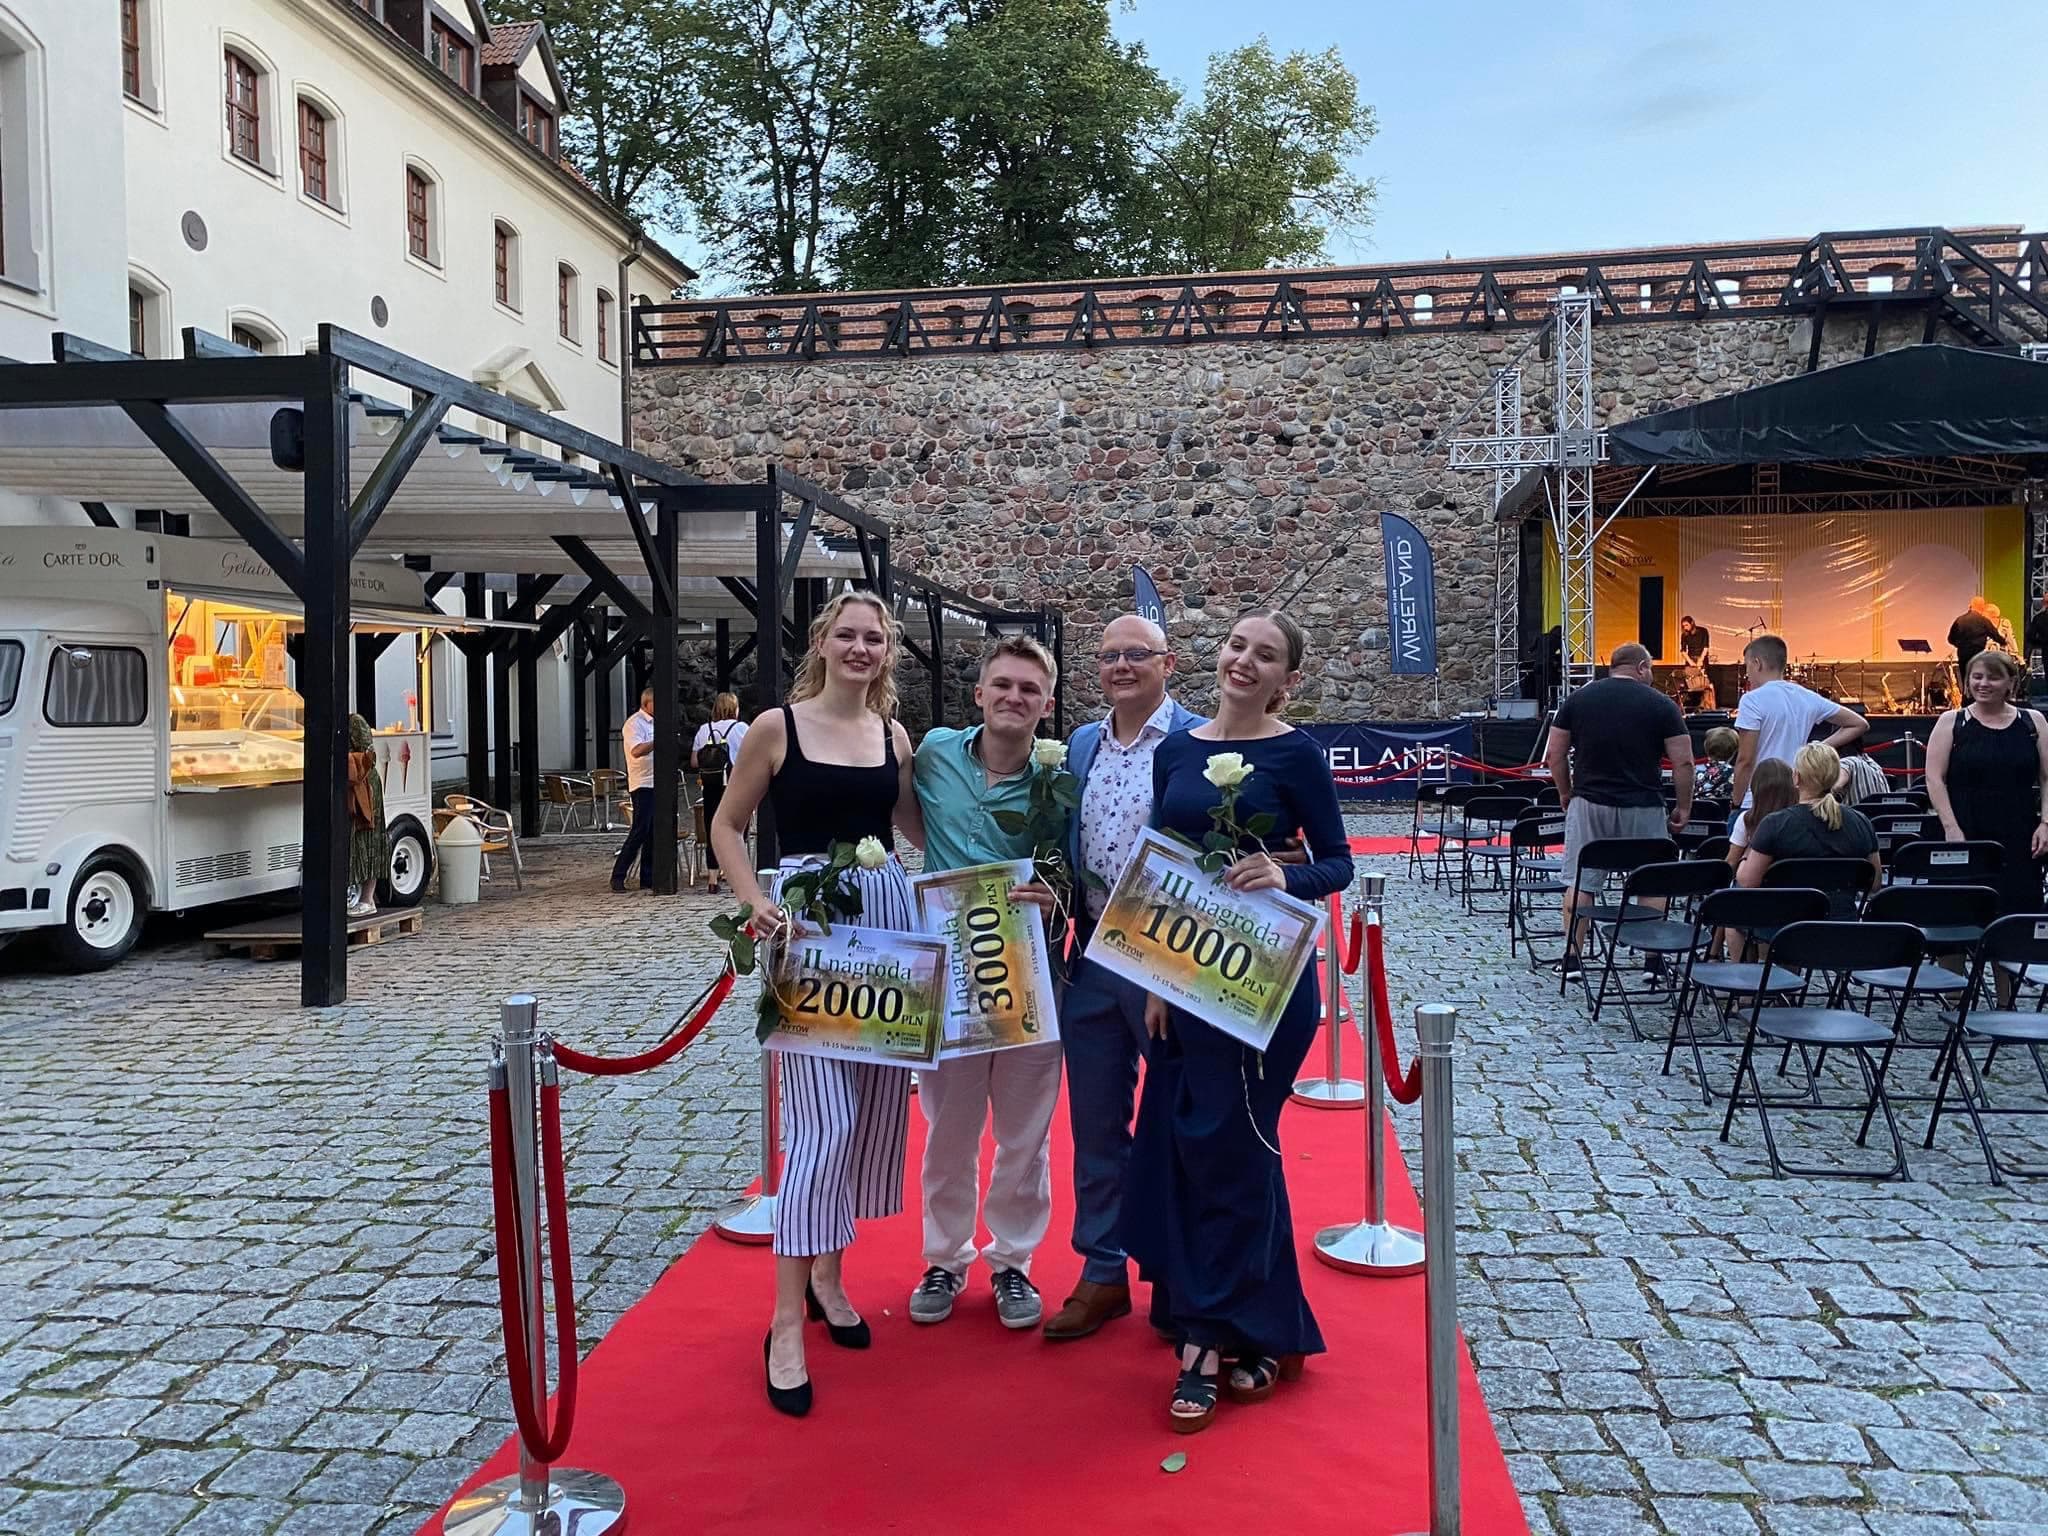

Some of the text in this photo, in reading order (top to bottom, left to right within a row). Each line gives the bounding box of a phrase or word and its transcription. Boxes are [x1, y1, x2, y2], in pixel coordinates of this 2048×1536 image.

[43, 552, 84, 568] CARTE
[1323, 746, 1446, 770] ELAND
[985, 883, 998, 906] PLN
[1159, 870, 1281, 948] III nagroda
[802, 947, 912, 981] II nagroda
[941, 916, 971, 1017] I nagroda
[966, 906, 1013, 1014] 3000
[1139, 904, 1253, 981] 1000
[1242, 977, 1268, 997] PLN
[796, 977, 924, 1027] 2000 PLN
